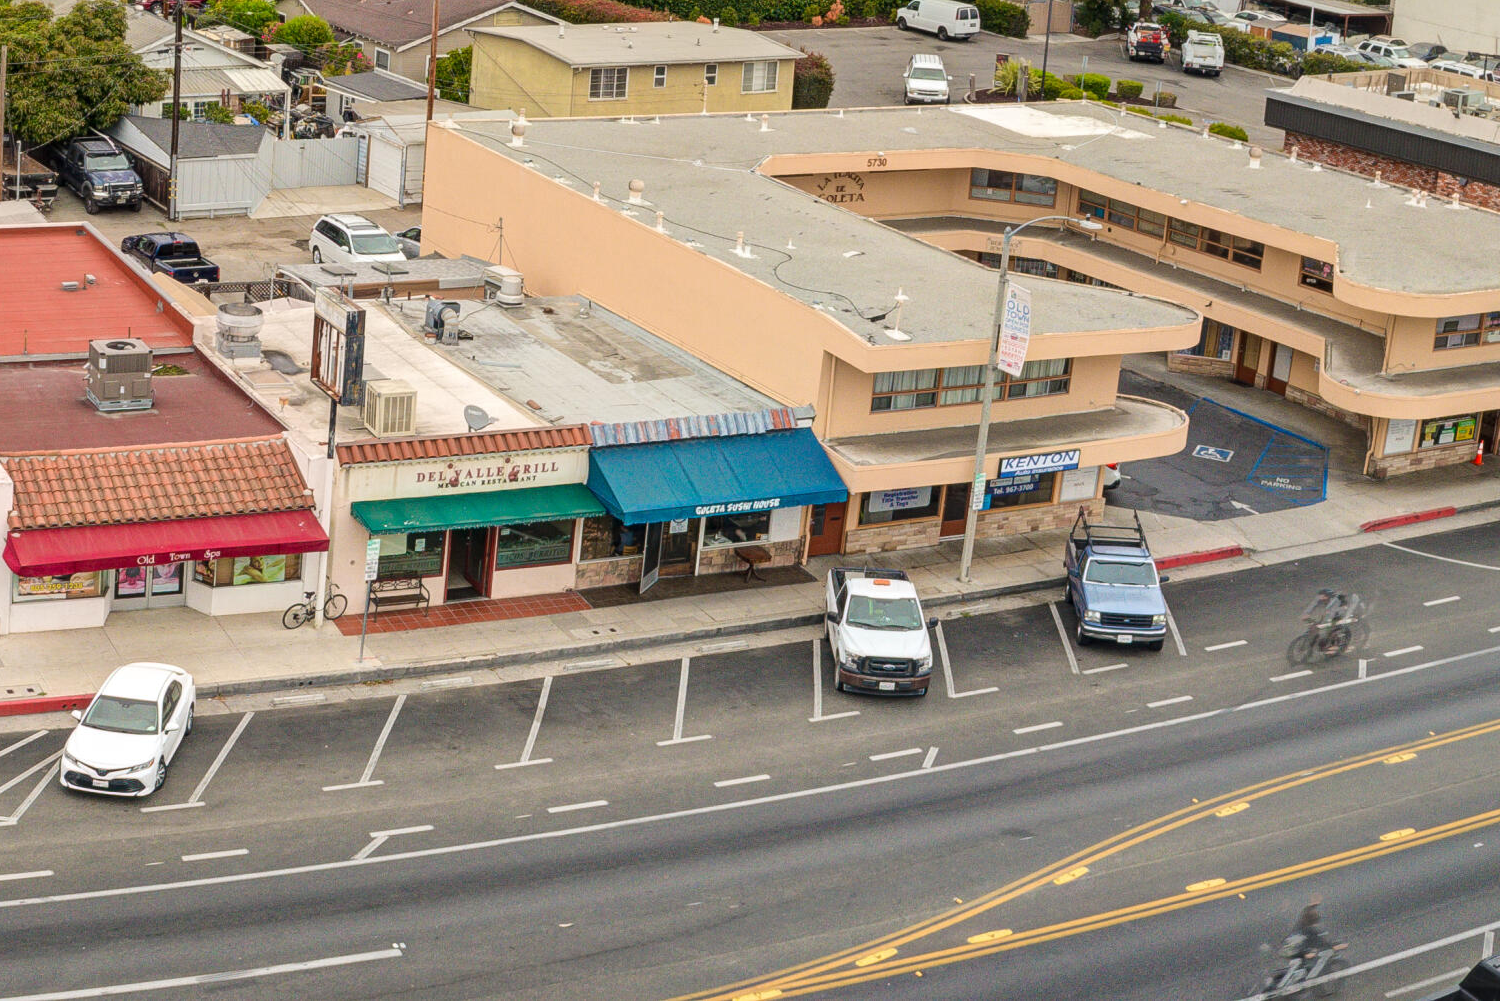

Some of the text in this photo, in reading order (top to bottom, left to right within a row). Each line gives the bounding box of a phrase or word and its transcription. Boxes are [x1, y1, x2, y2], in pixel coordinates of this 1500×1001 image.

[867, 158, 887, 167] 5730
[817, 178, 831, 191] LA
[1007, 300, 1029, 315] OLD
[1006, 309, 1029, 323] TOWN
[1005, 450, 1076, 470] KENTON
[416, 462, 560, 483] DEL VALLE GRILL
[437, 475, 538, 489] MECAN RESTAANT
[1260, 480, 1302, 490] PARKING
[695, 498, 780, 515] GOLETA SUSHI HOUSE
[137, 549, 221, 566] Old Town Spa
